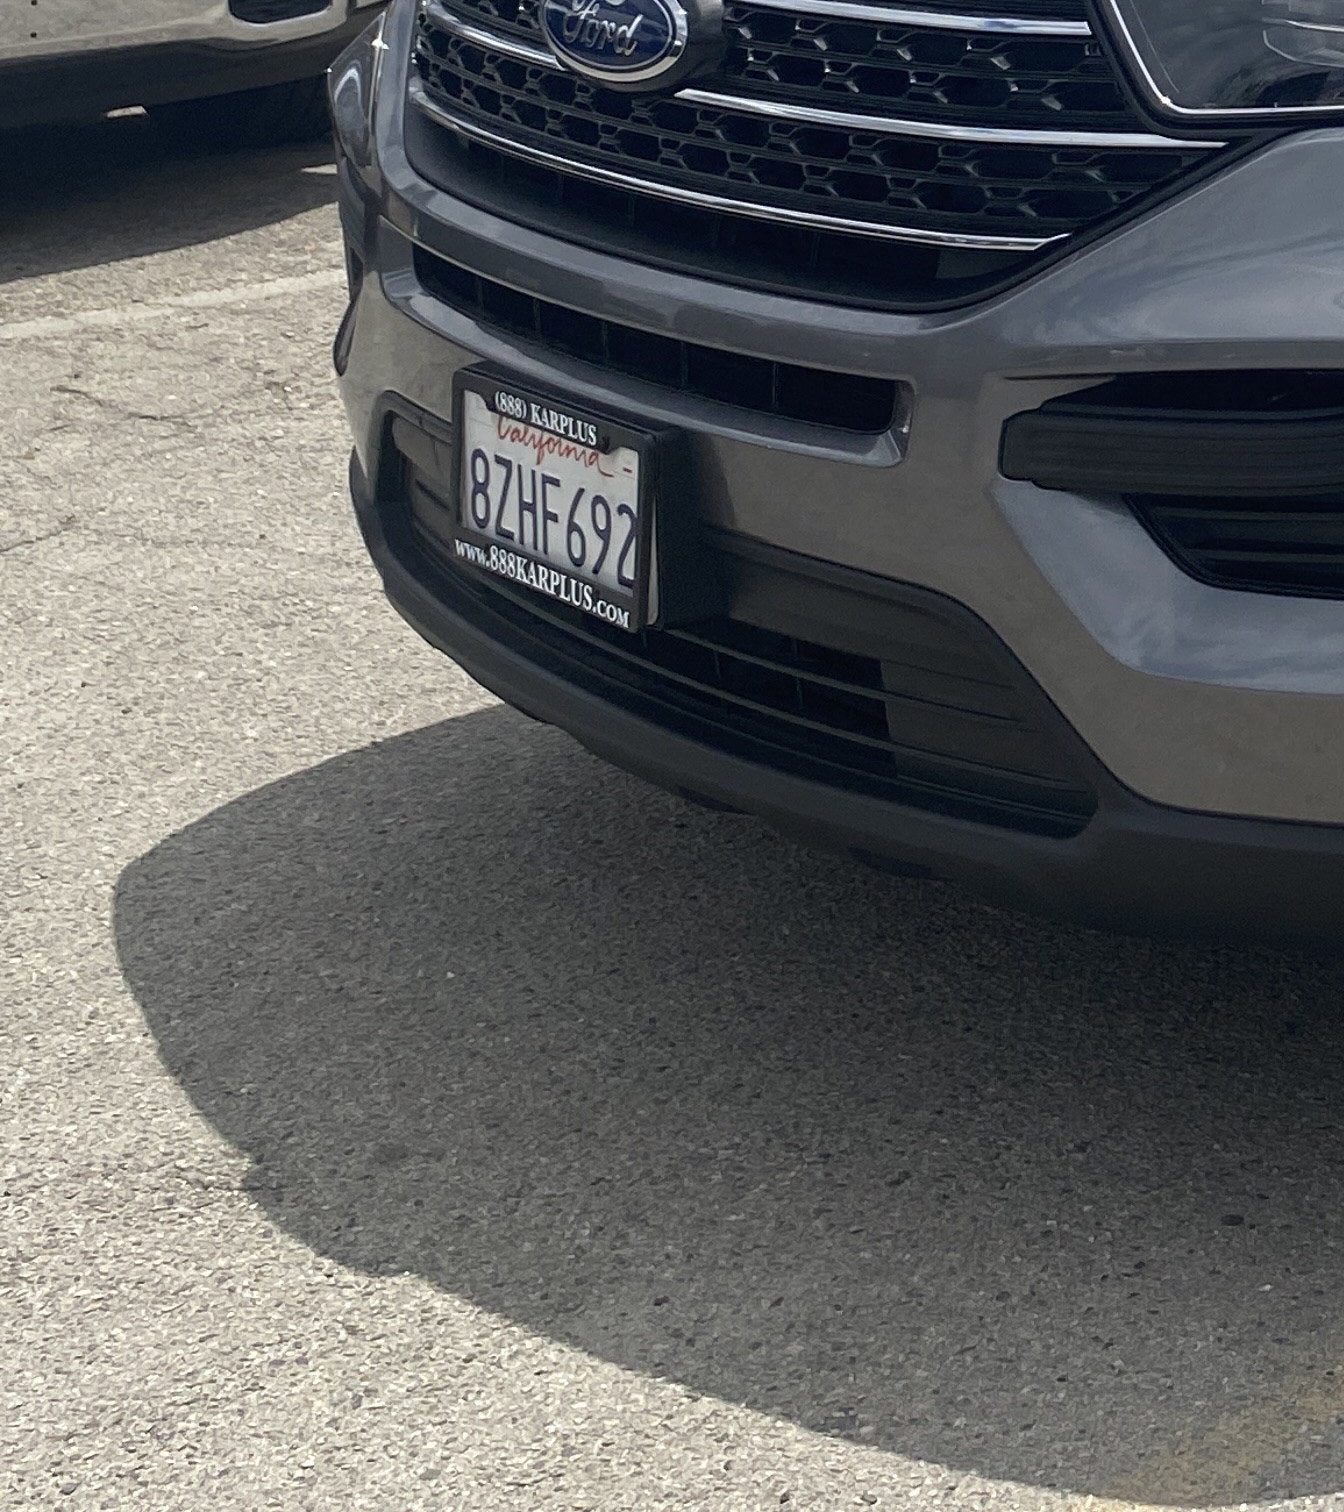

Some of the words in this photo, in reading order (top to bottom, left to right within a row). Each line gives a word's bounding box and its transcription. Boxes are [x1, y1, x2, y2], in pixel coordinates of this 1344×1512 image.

[494, 390, 528, 419] (888)
[530, 402, 598, 447] KARPLUS
[497, 415, 615, 478] California
[470, 448, 638, 589] 8ZHF692
